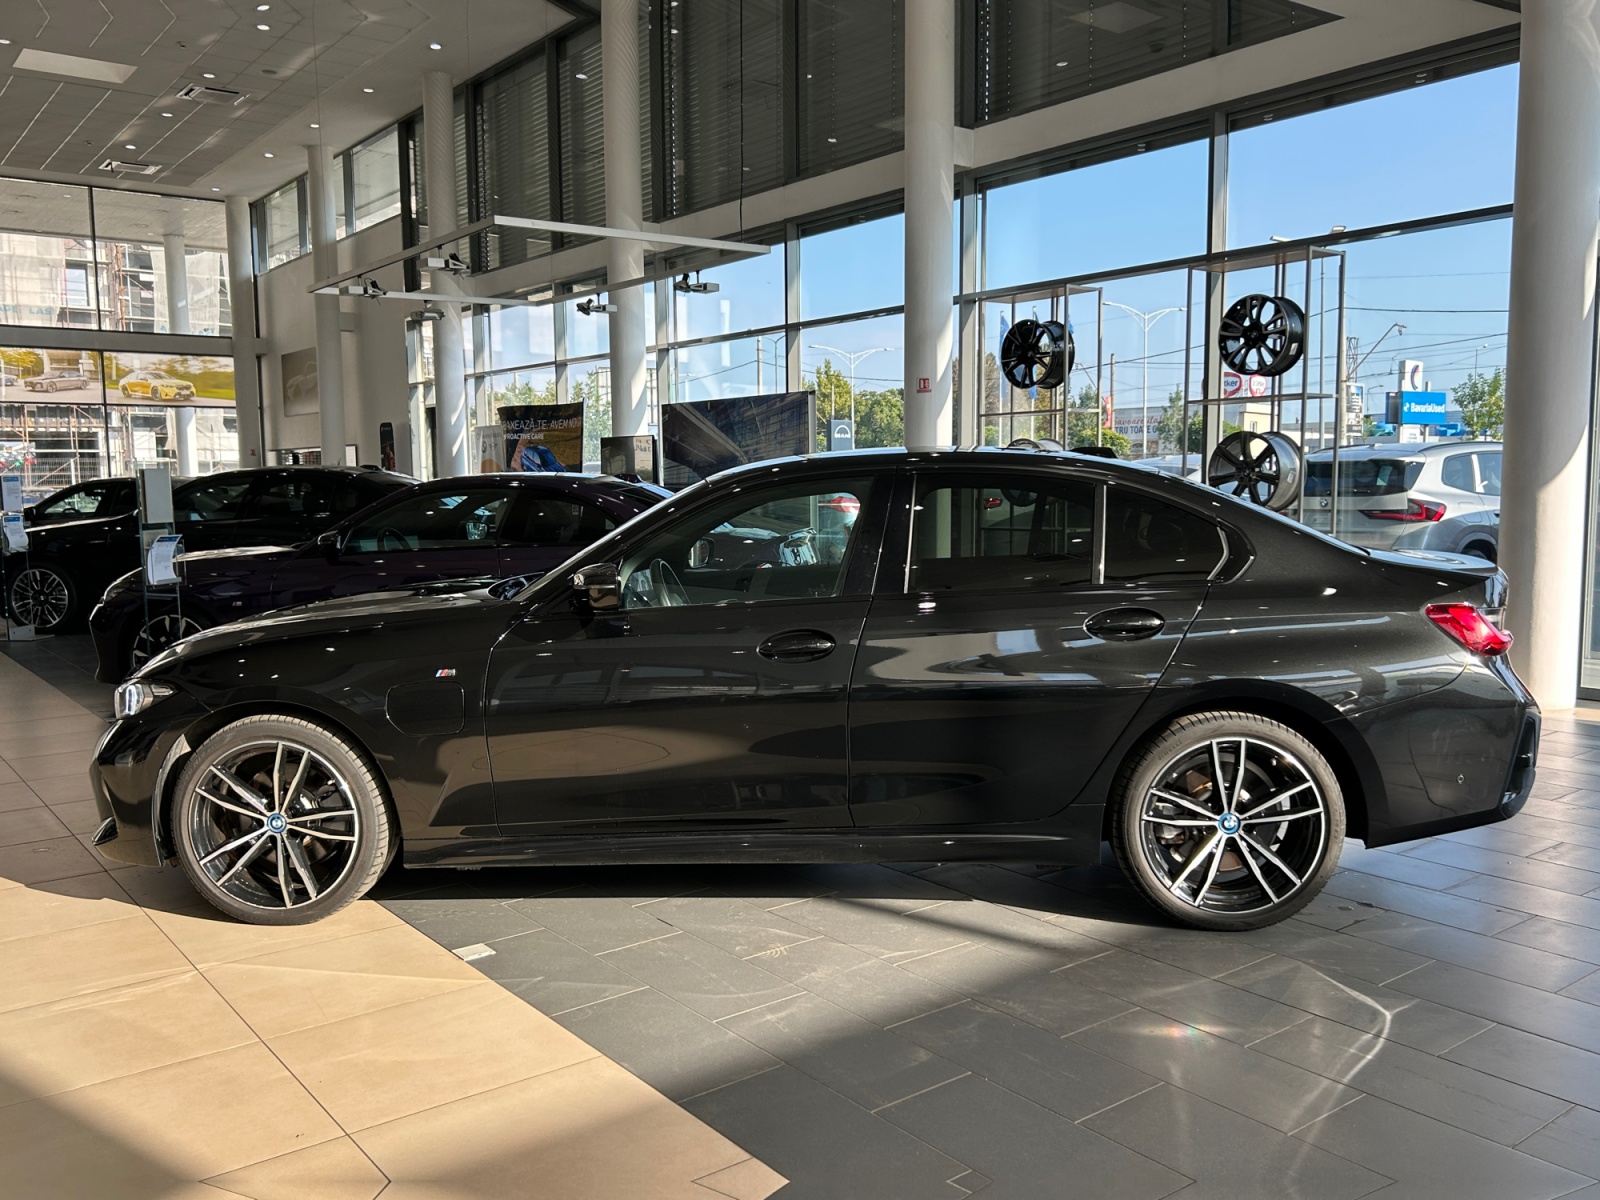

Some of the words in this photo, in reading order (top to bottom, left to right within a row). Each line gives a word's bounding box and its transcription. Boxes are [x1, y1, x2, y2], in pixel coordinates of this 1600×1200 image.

[1410, 402, 1445, 413] BavariaUsed
[1130, 425, 1152, 434] TOAE
[531, 432, 545, 440] CARE
